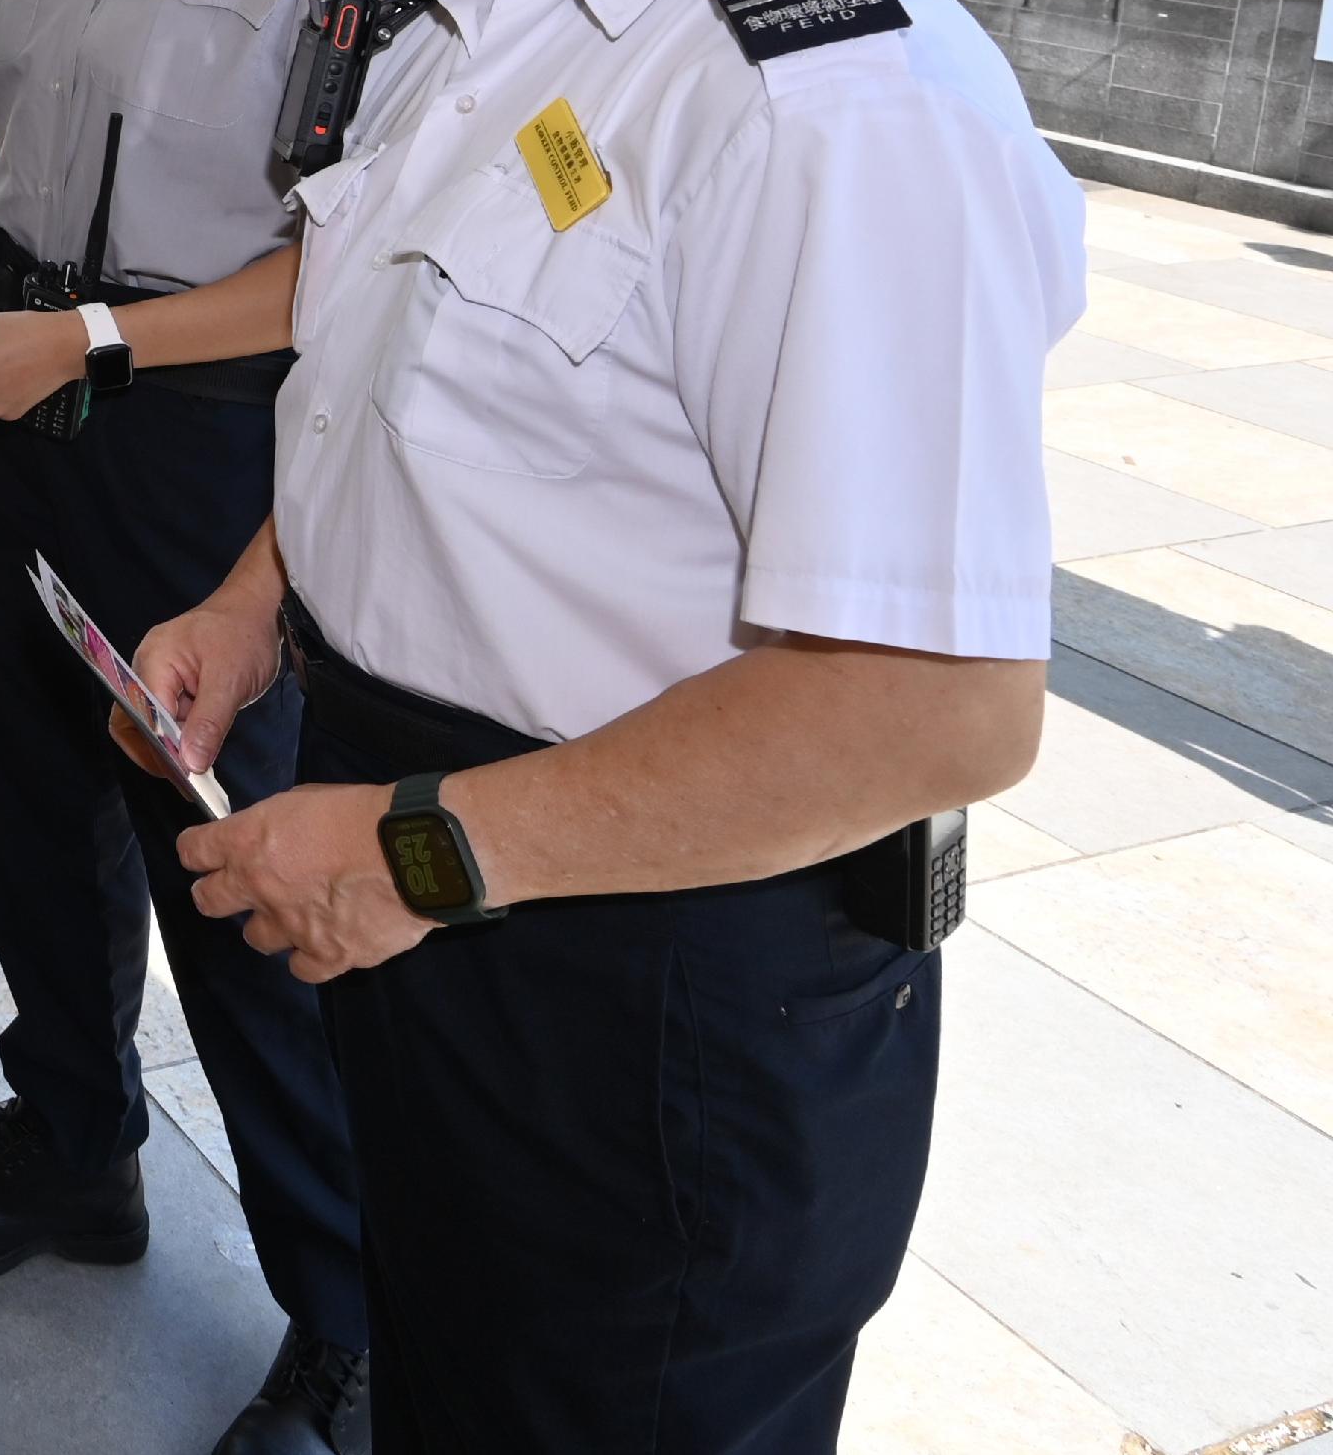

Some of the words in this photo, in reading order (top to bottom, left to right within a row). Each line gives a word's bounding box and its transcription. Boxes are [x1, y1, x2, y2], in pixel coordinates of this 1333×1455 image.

[780, 9, 856, 33] FEHD
[395, 832, 432, 866] 25
[406, 863, 440, 896] 10
